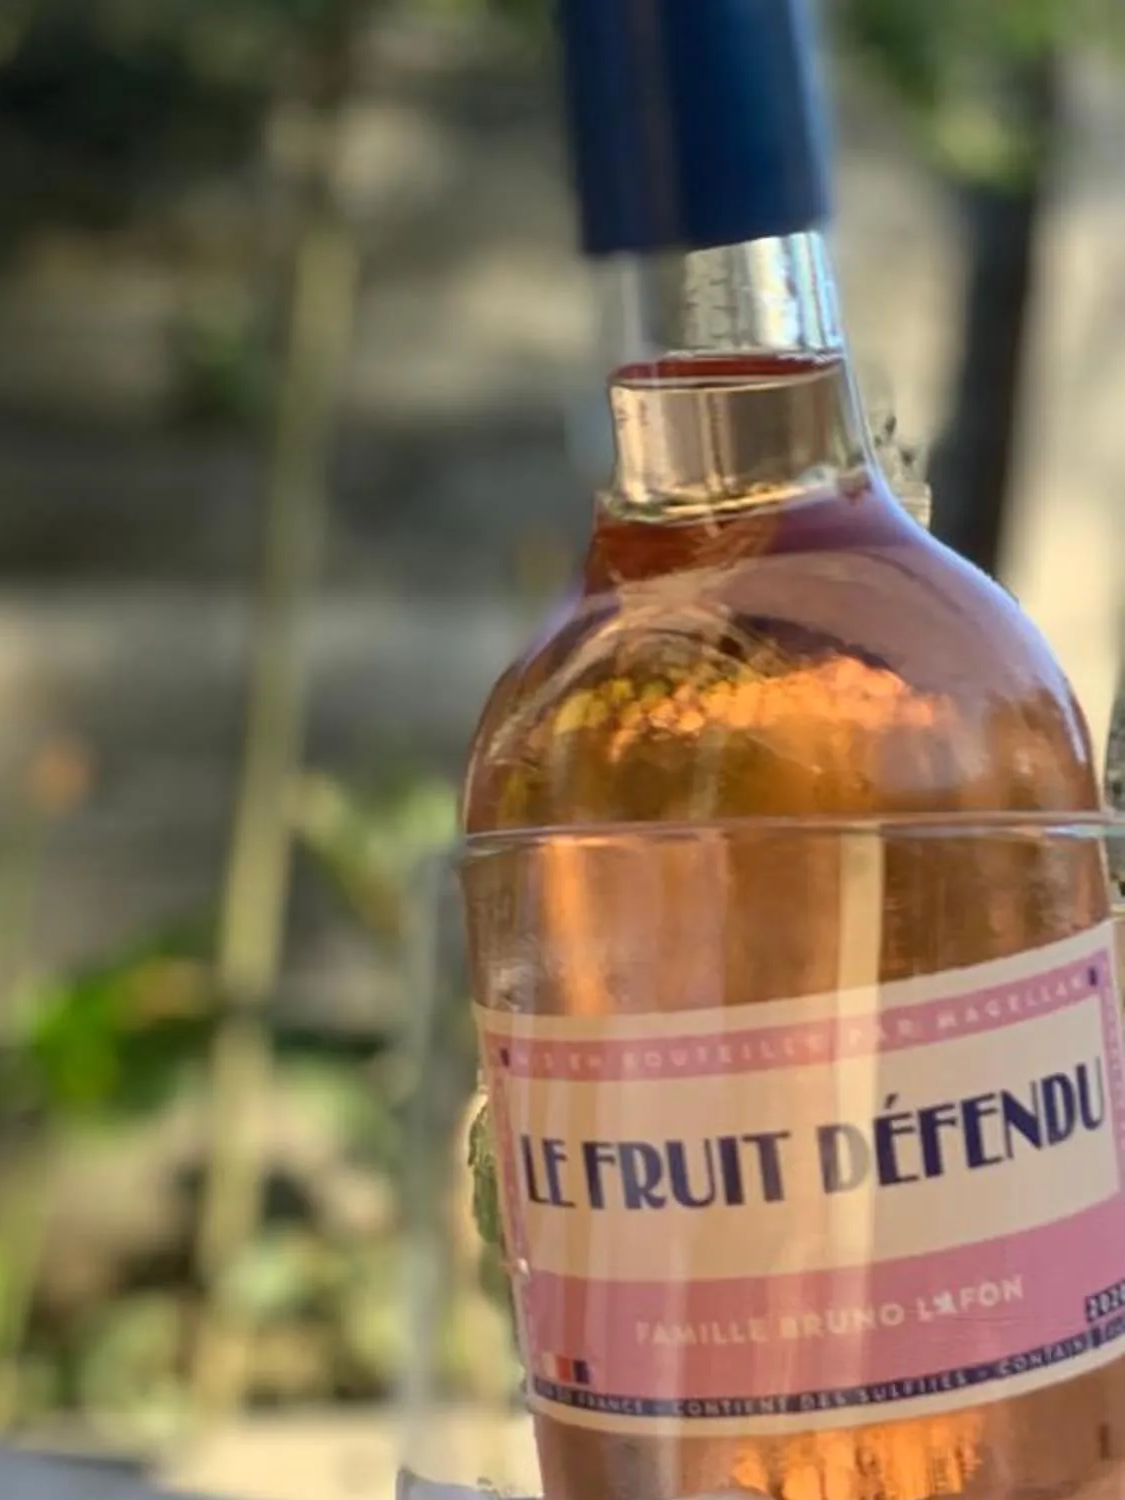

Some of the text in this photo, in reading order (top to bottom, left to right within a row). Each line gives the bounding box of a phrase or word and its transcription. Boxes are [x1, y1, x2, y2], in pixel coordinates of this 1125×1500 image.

[520, 1132, 576, 1209] LE
[582, 1130, 790, 1211] FRUIT
[817, 1057, 1105, 1196] DÉFENDU
[635, 1315, 768, 1346] FAMILLE
[779, 1301, 905, 1340] BRUNO
[673, 1395, 787, 1416] CONTIENT
[802, 1389, 847, 1410] DES
[857, 1369, 967, 1405] SULFITES
